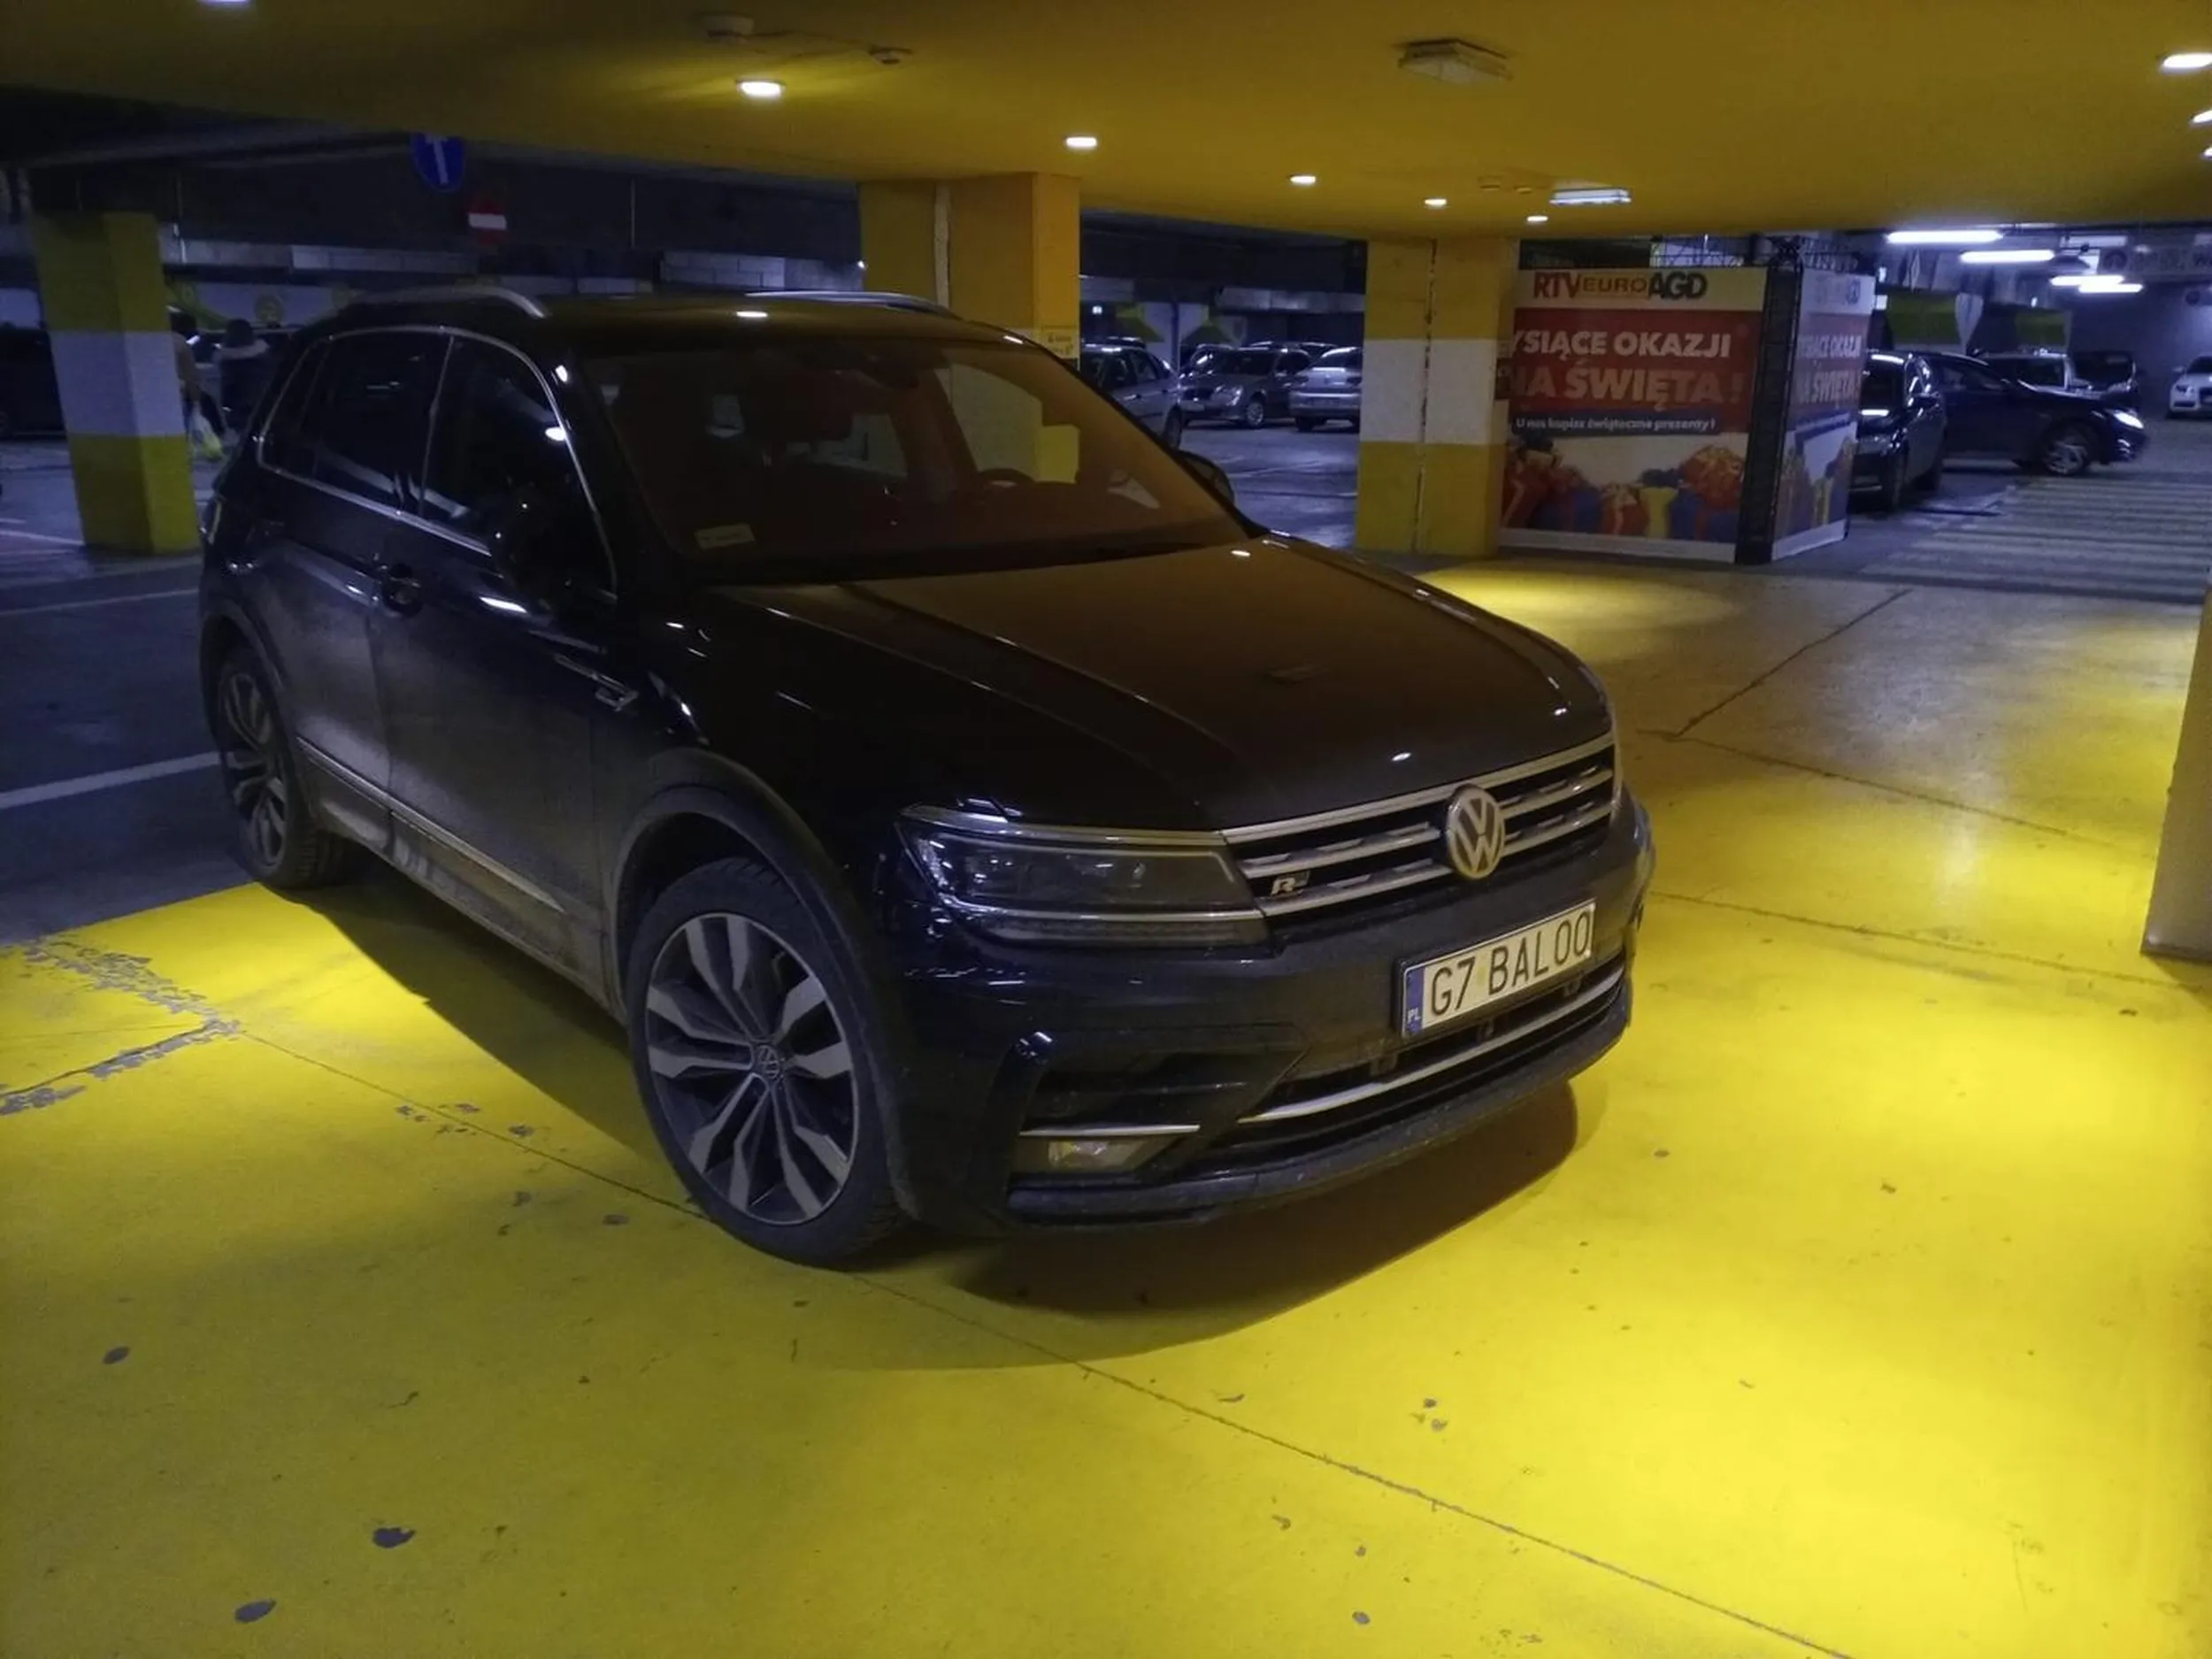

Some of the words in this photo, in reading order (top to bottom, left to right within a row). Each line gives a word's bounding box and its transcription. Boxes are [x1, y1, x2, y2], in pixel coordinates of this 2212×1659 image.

[1614, 330, 1732, 359] OKAZJI
[1431, 956, 1477, 1018] G7
[1407, 1007, 1422, 1025] PL
